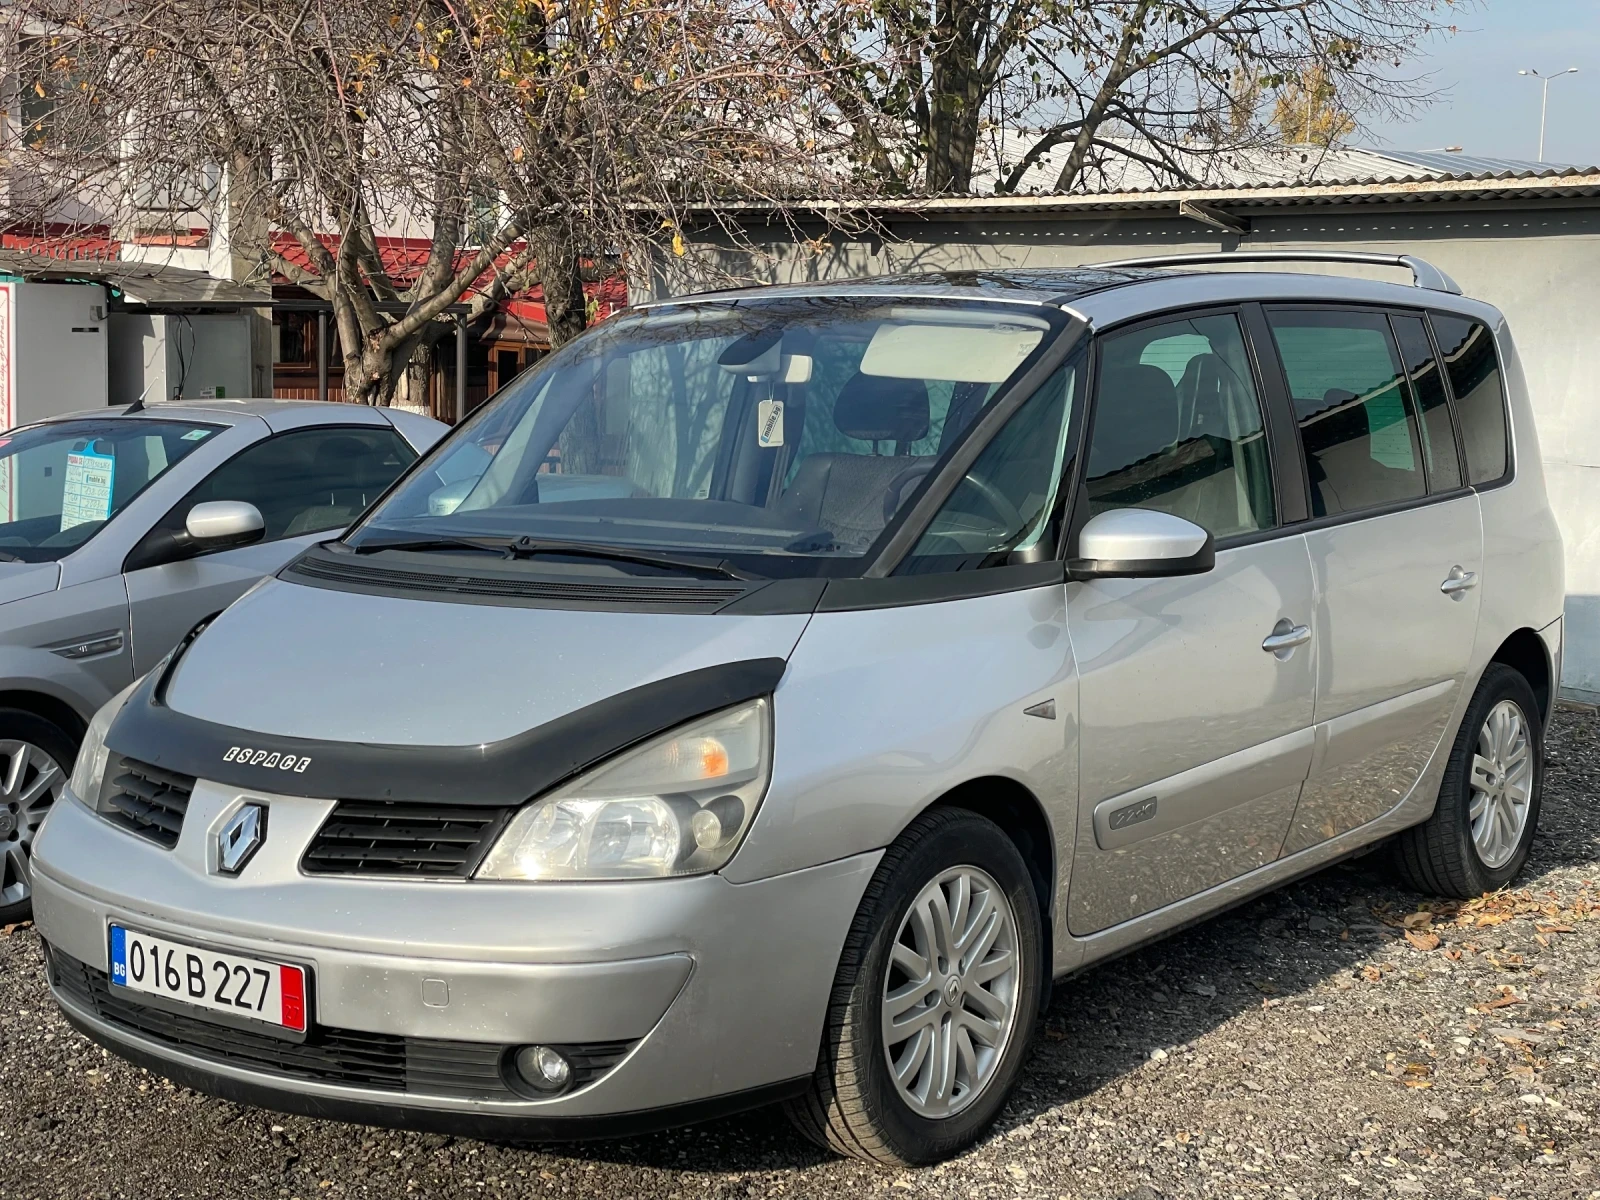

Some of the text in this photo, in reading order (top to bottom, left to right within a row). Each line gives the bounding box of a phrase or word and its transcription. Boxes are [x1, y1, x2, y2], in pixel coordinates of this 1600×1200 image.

[764, 406, 781, 437] mobile.bg
[223, 747, 311, 773] ESPACE
[114, 962, 125, 977] BG
[285, 1004, 299, 1020] 27
